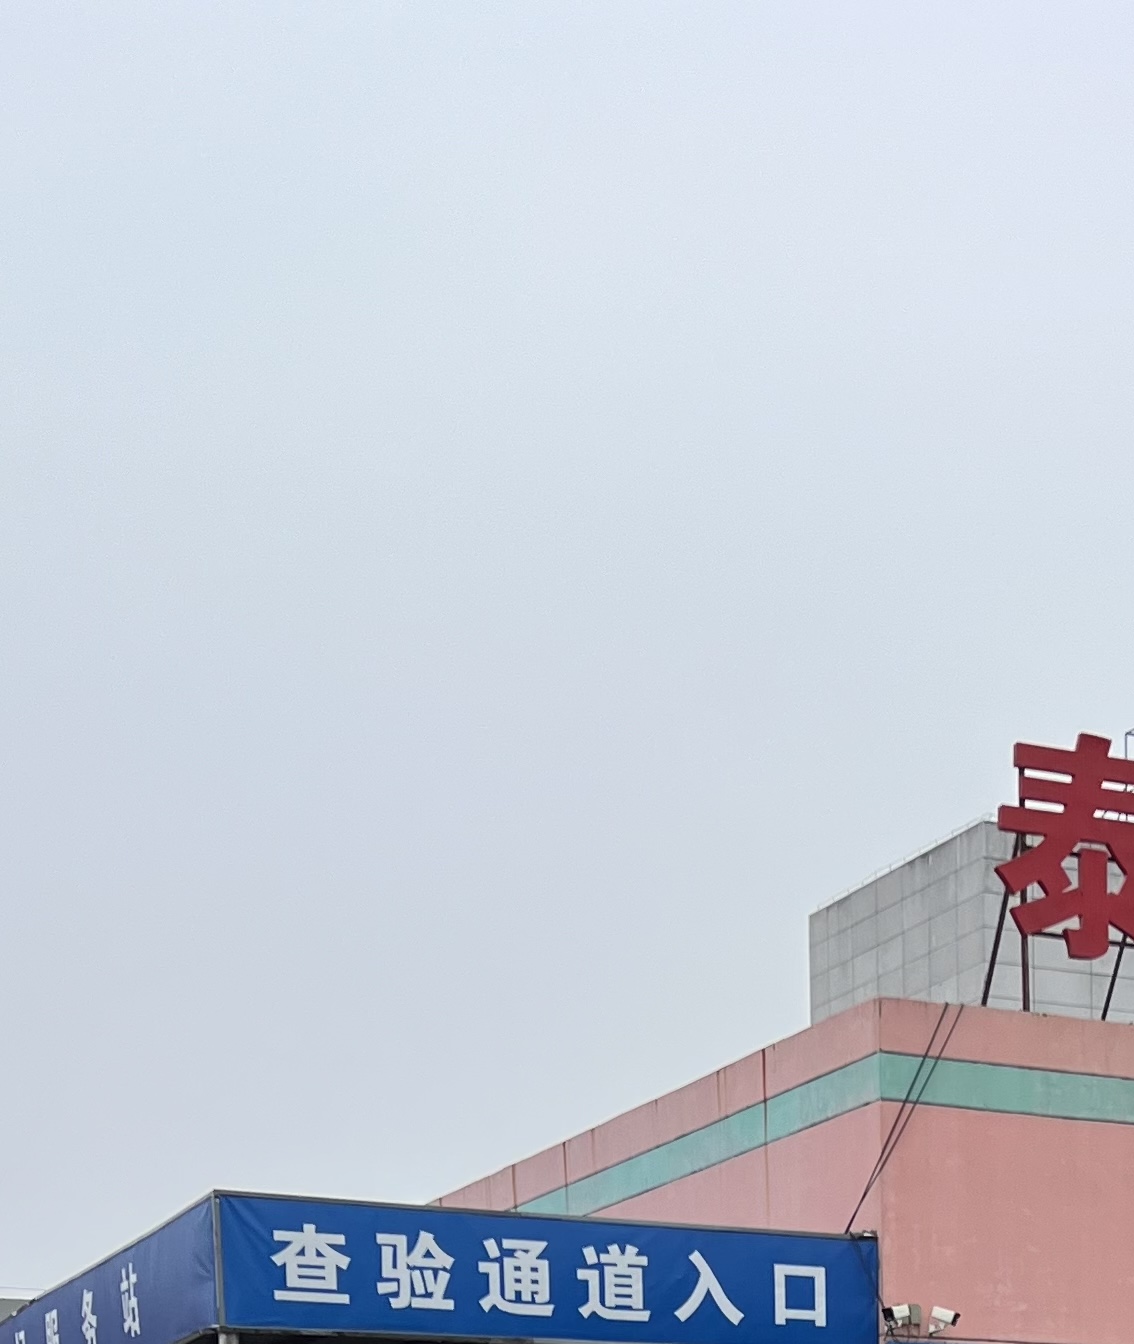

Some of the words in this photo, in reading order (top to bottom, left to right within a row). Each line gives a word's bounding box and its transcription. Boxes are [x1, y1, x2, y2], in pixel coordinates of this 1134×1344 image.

[271, 1223, 828, 1329] 查验通道入口
